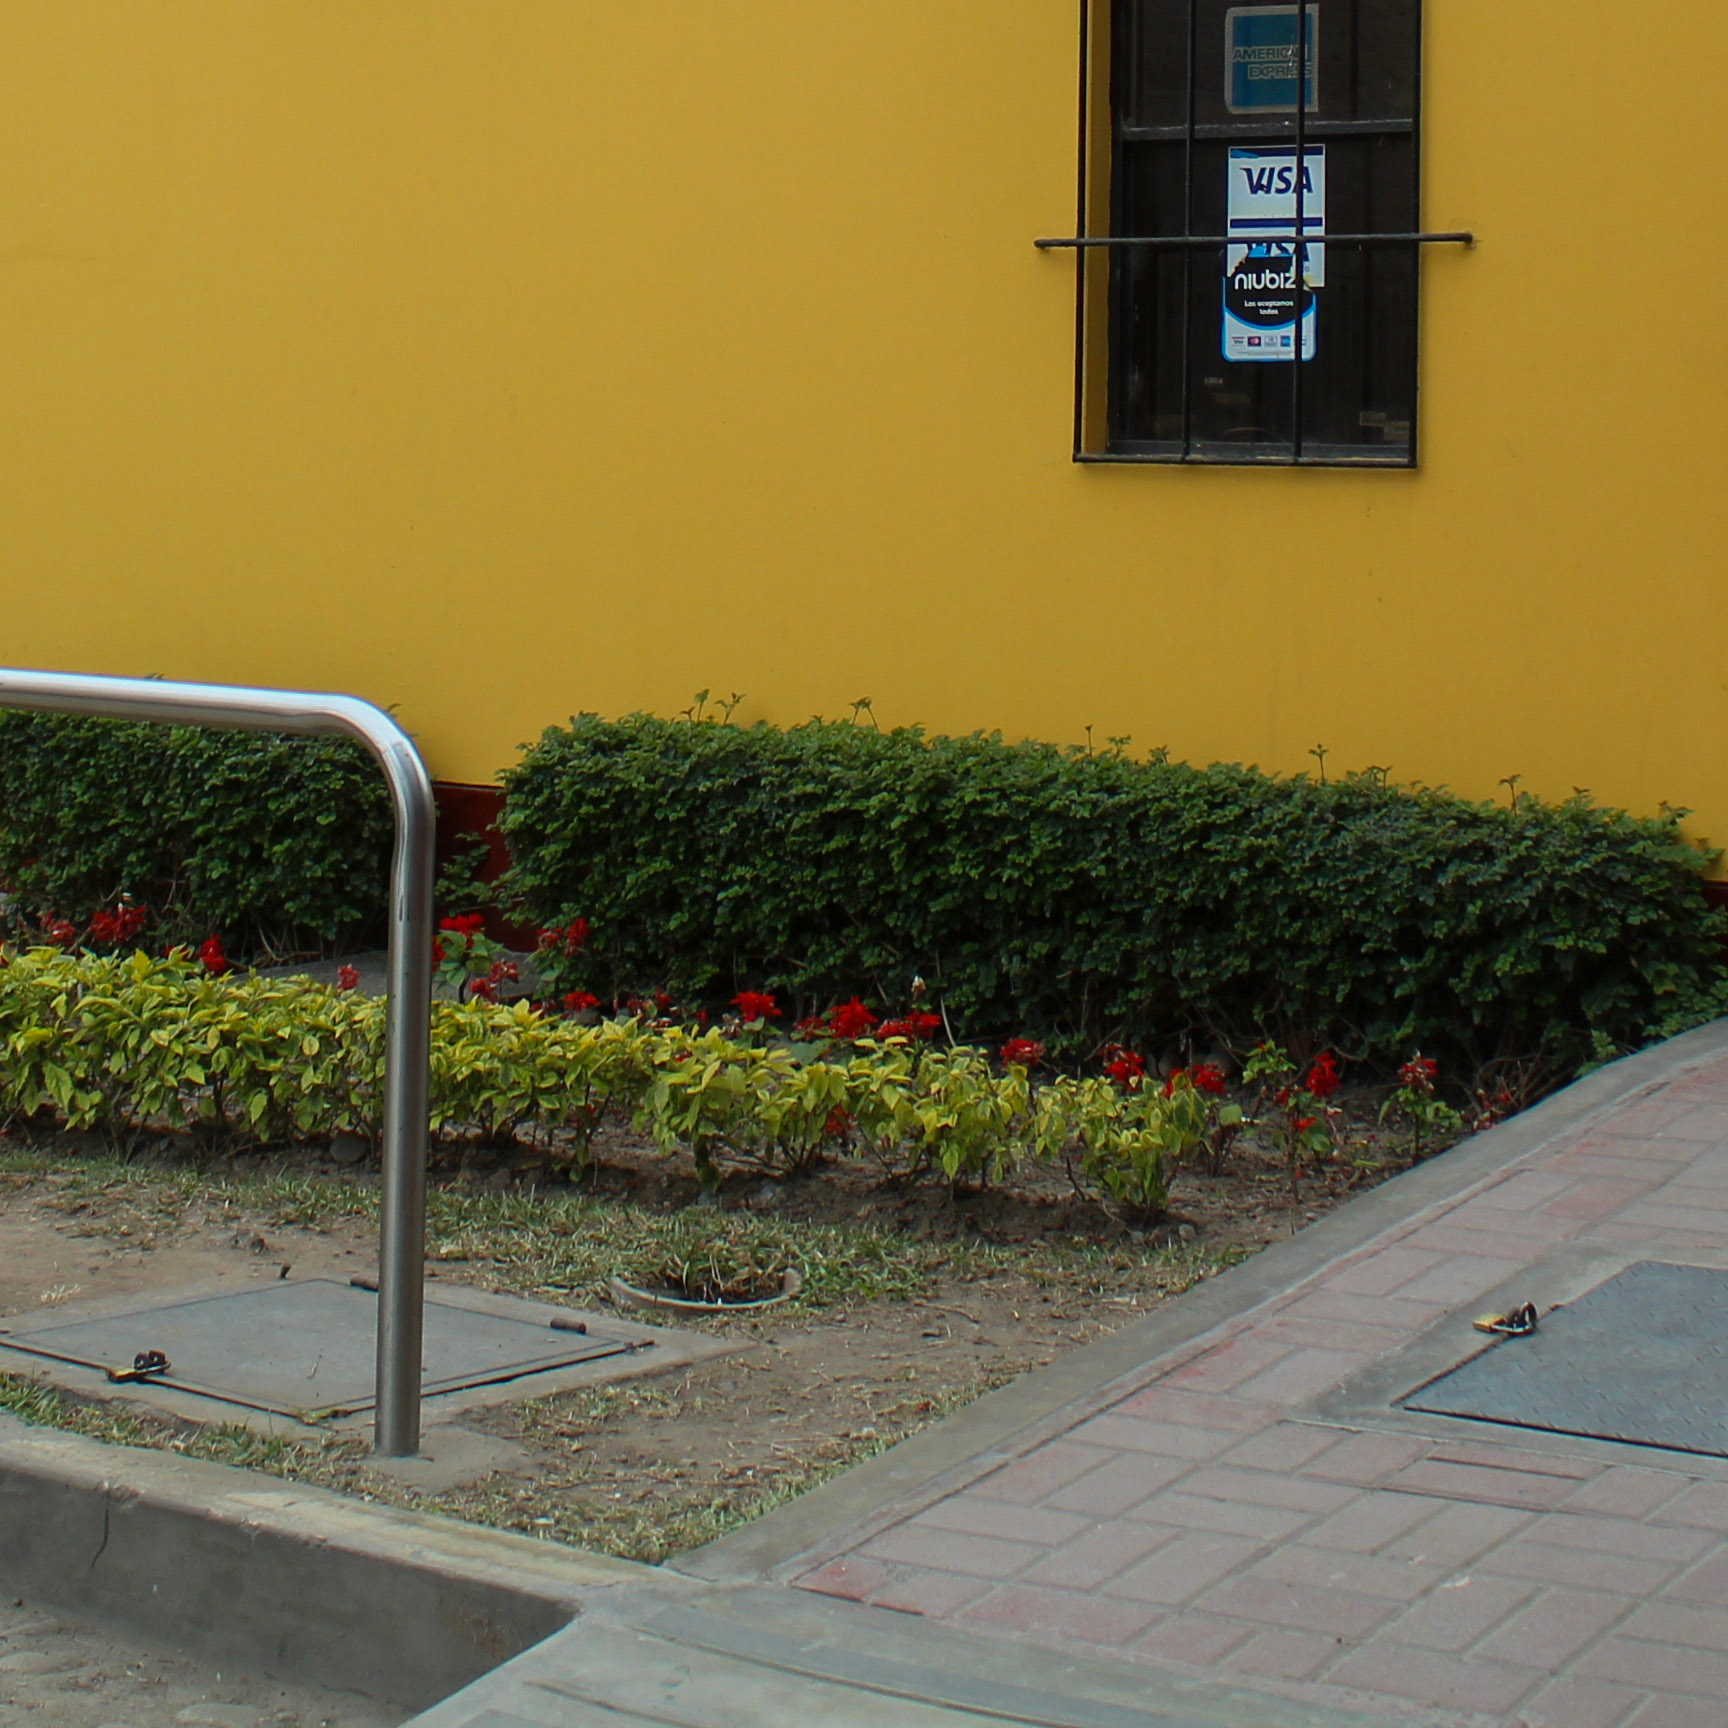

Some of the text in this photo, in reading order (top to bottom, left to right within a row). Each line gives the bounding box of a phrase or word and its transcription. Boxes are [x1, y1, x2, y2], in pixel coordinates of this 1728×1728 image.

[1232, 46, 1305, 60] AMERICA
[1239, 166, 1314, 195] VISA
[1234, 268, 1297, 290] niubiz
